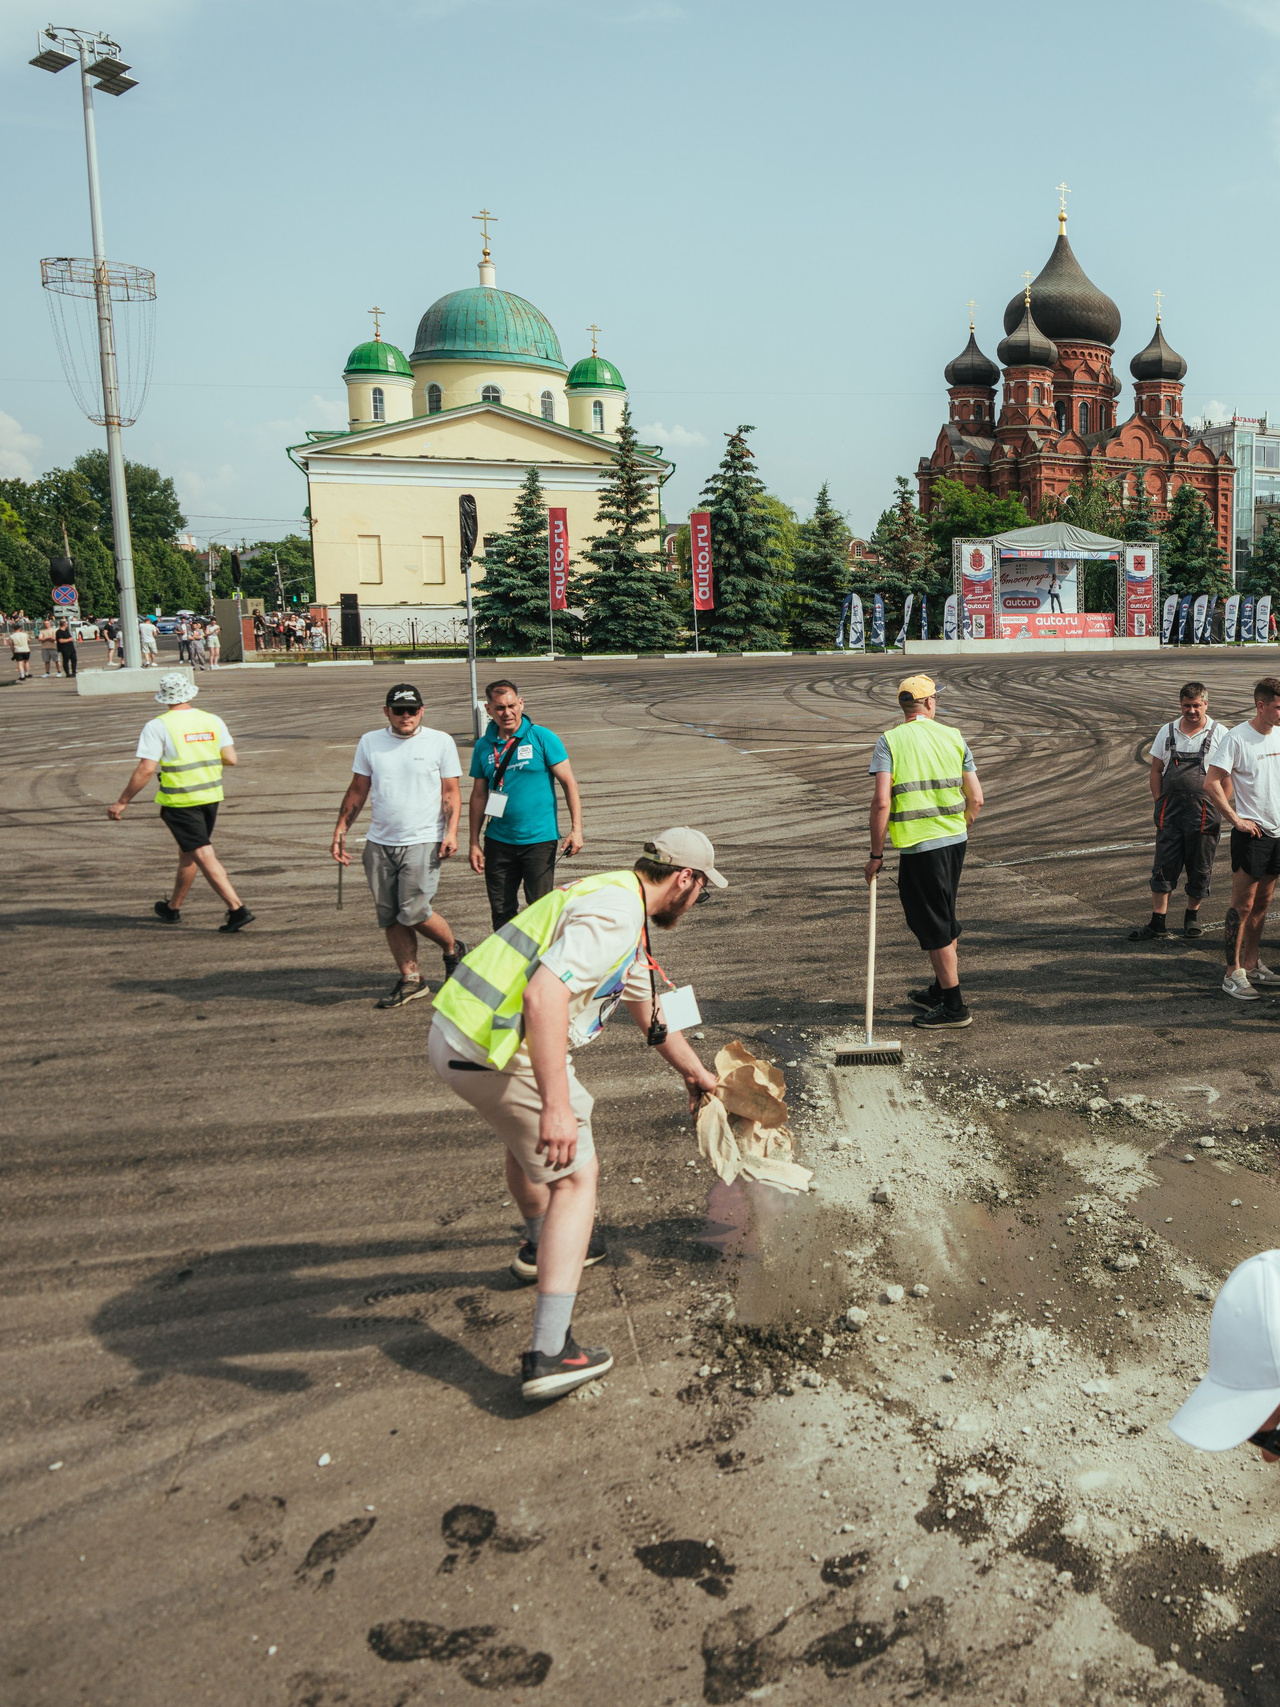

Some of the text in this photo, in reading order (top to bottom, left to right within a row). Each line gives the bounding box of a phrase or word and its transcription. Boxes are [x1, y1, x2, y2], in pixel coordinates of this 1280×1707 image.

[553, 520, 566, 599] auto.ru
[696, 525, 710, 599] auto.ru
[1044, 550, 1089, 559] ДЕНЬ РОССИИ
[1035, 615, 1078, 626] auto.ru
